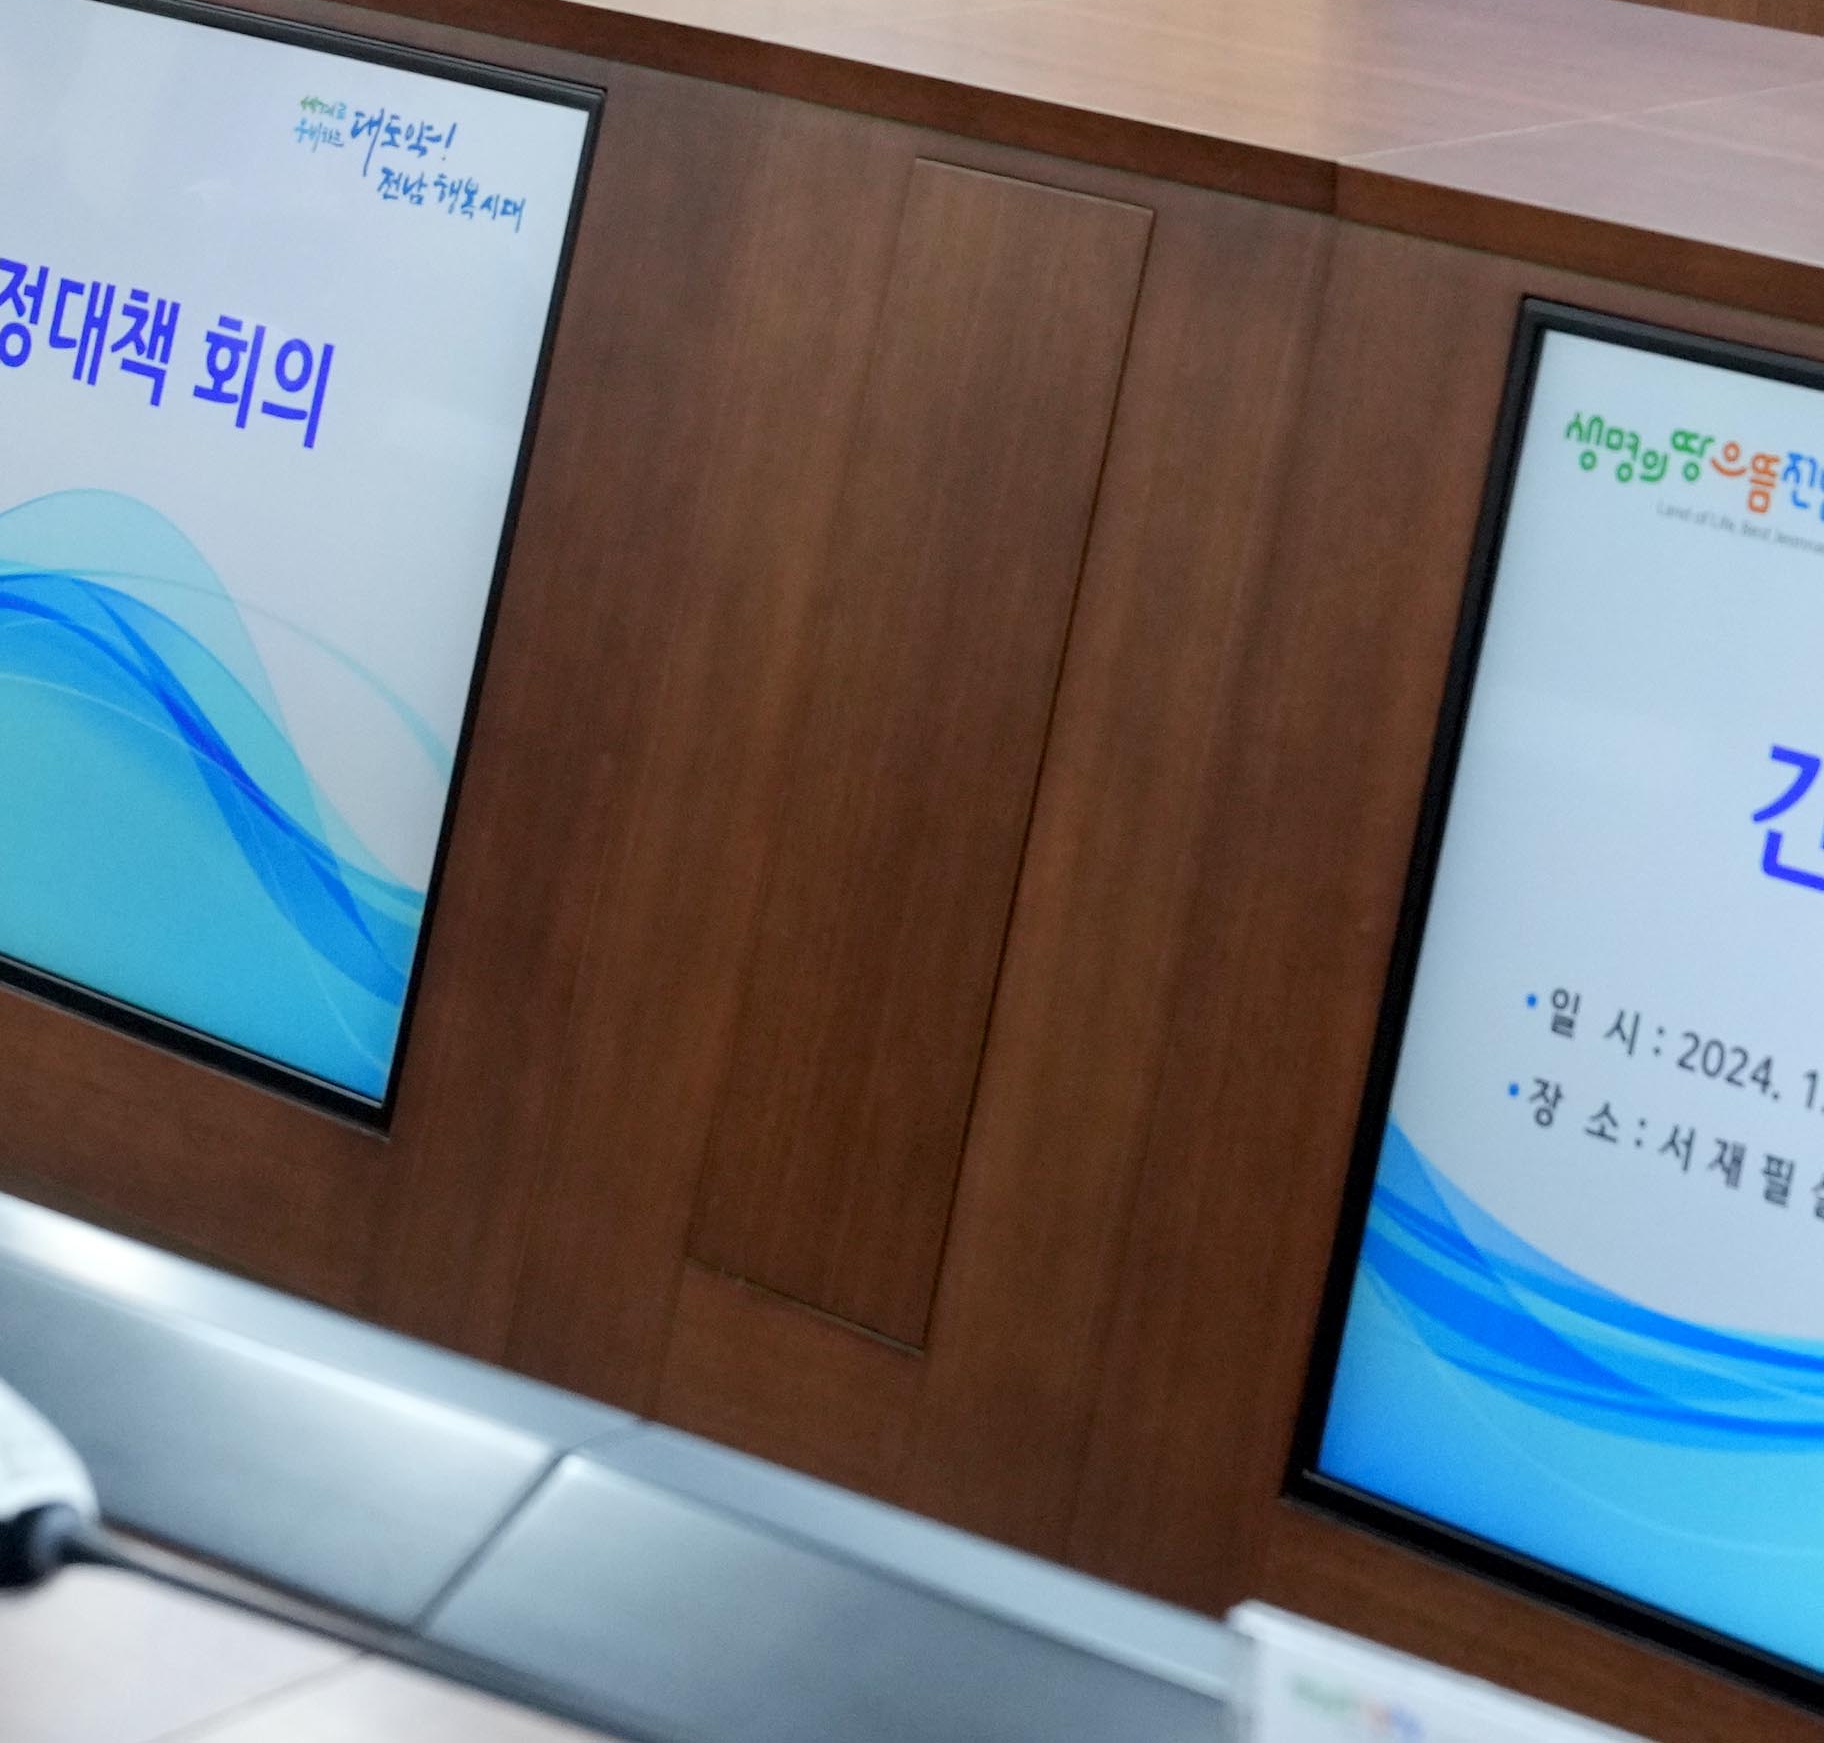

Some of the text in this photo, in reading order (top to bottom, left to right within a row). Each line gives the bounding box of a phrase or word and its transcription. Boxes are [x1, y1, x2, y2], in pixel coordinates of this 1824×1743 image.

[350, 108, 457, 177] 대도약!
[377, 166, 427, 206] 전남
[192, 315, 334, 450] 회의
[1676, 1032, 1780, 1101] 2024.
